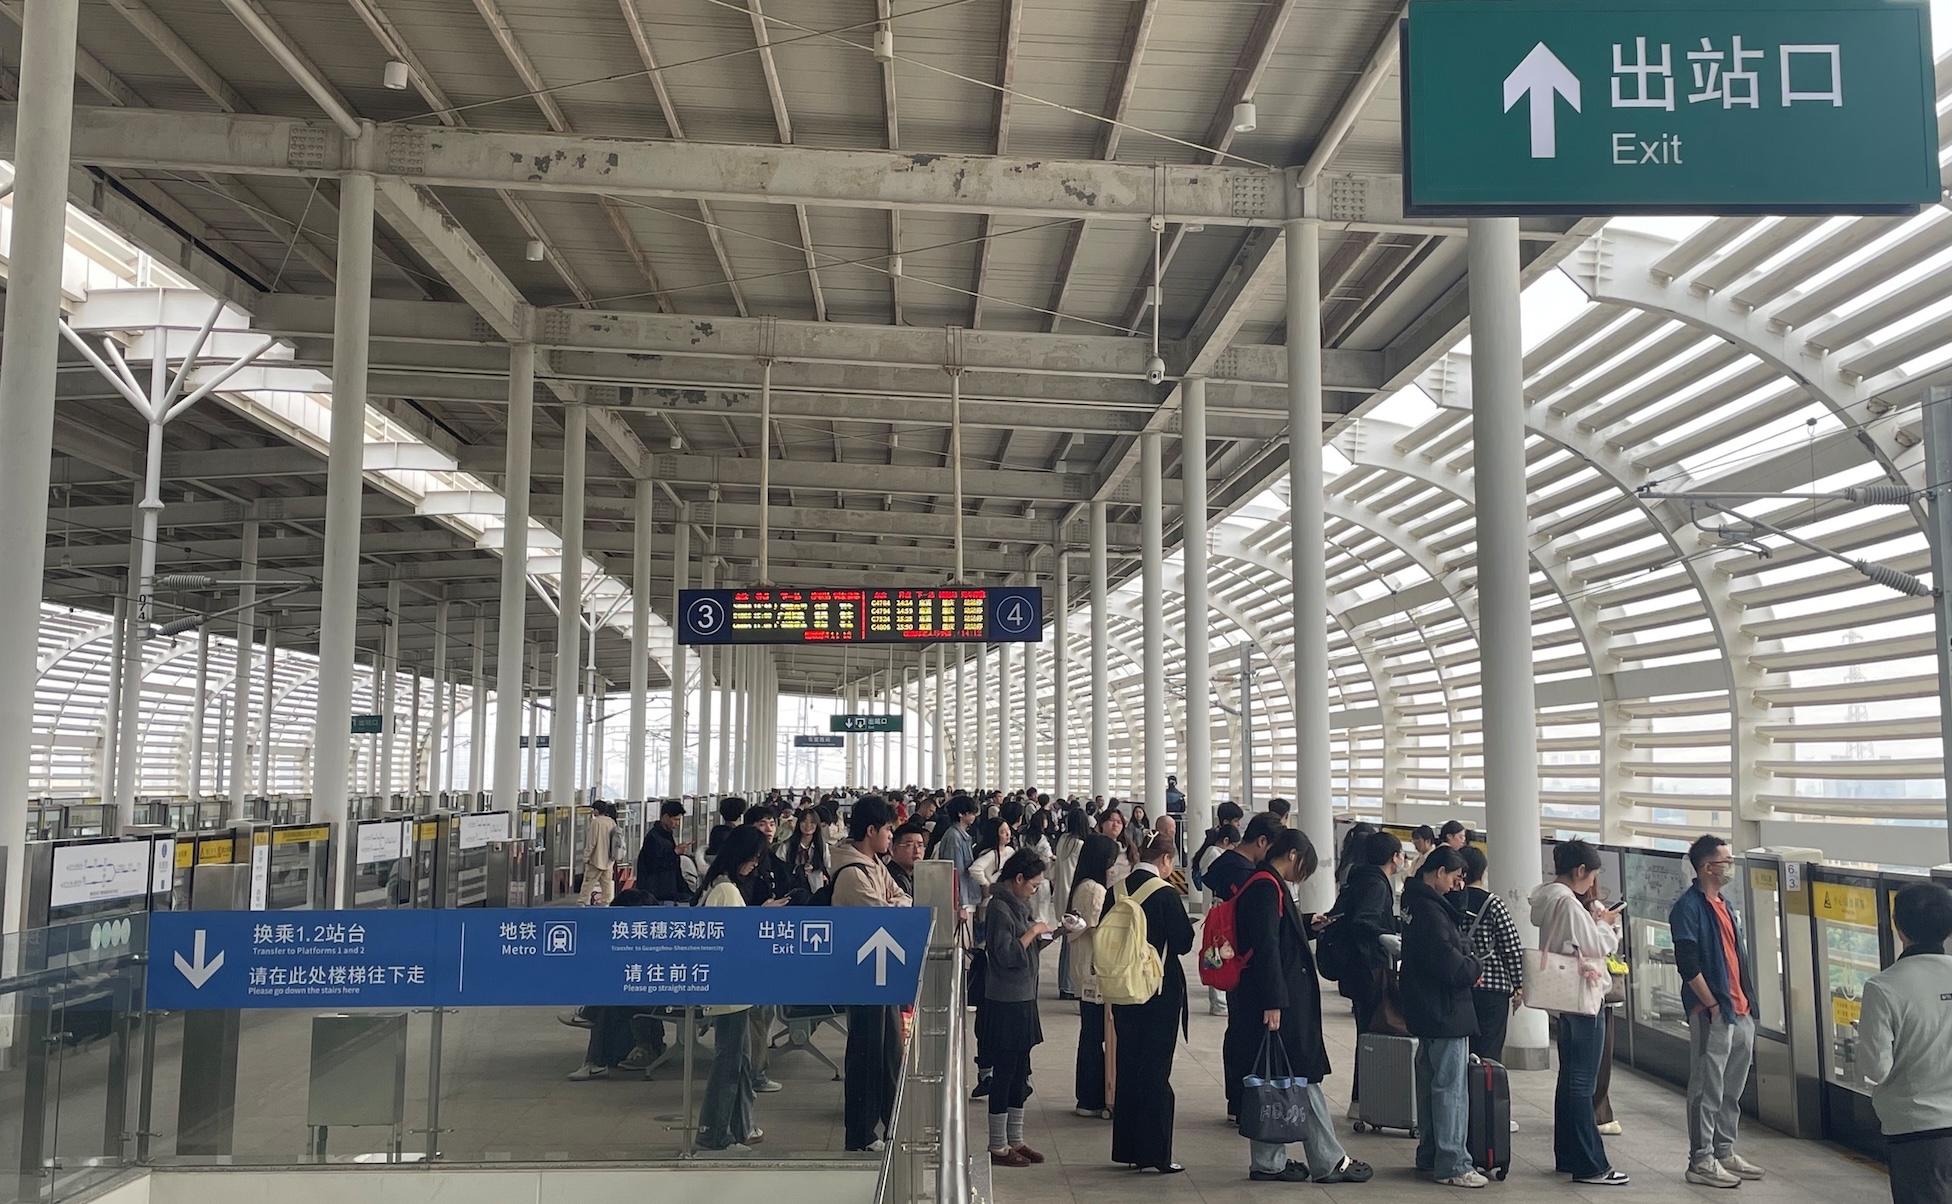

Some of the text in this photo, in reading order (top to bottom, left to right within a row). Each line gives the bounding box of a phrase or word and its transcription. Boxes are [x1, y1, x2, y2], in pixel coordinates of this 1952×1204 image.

[1610, 35, 1844, 112] 出站口
[1612, 132, 1684, 165] Exit
[697, 604, 715, 629] 3
[1006, 602, 1024, 626] 4
[253, 924, 366, 944] 换乘1.2站台
[499, 921, 537, 941] 地铁
[611, 921, 725, 941] 换乘穗深城际
[758, 920, 795, 940] 出站
[253, 946, 286, 956] Transfer
[287, 947, 296, 956] to
[297, 946, 337, 955] Platforms
[343, 946, 359, 955] and
[360, 946, 365, 955] 2
[501, 944, 537, 955] Metro
[611, 944, 634, 952] Transfer
[642, 944, 701, 953] Guangzhou-Shenzhen
[701, 944, 725, 952] Intercity
[772, 943, 795, 955] Exit
[248, 964, 425, 986] 请在此处楼梯往下走
[623, 963, 710, 983] 请往前行
[248, 985, 360, 997] Please go down the stairs here
[623, 983, 710, 994] Please go straight ahead
